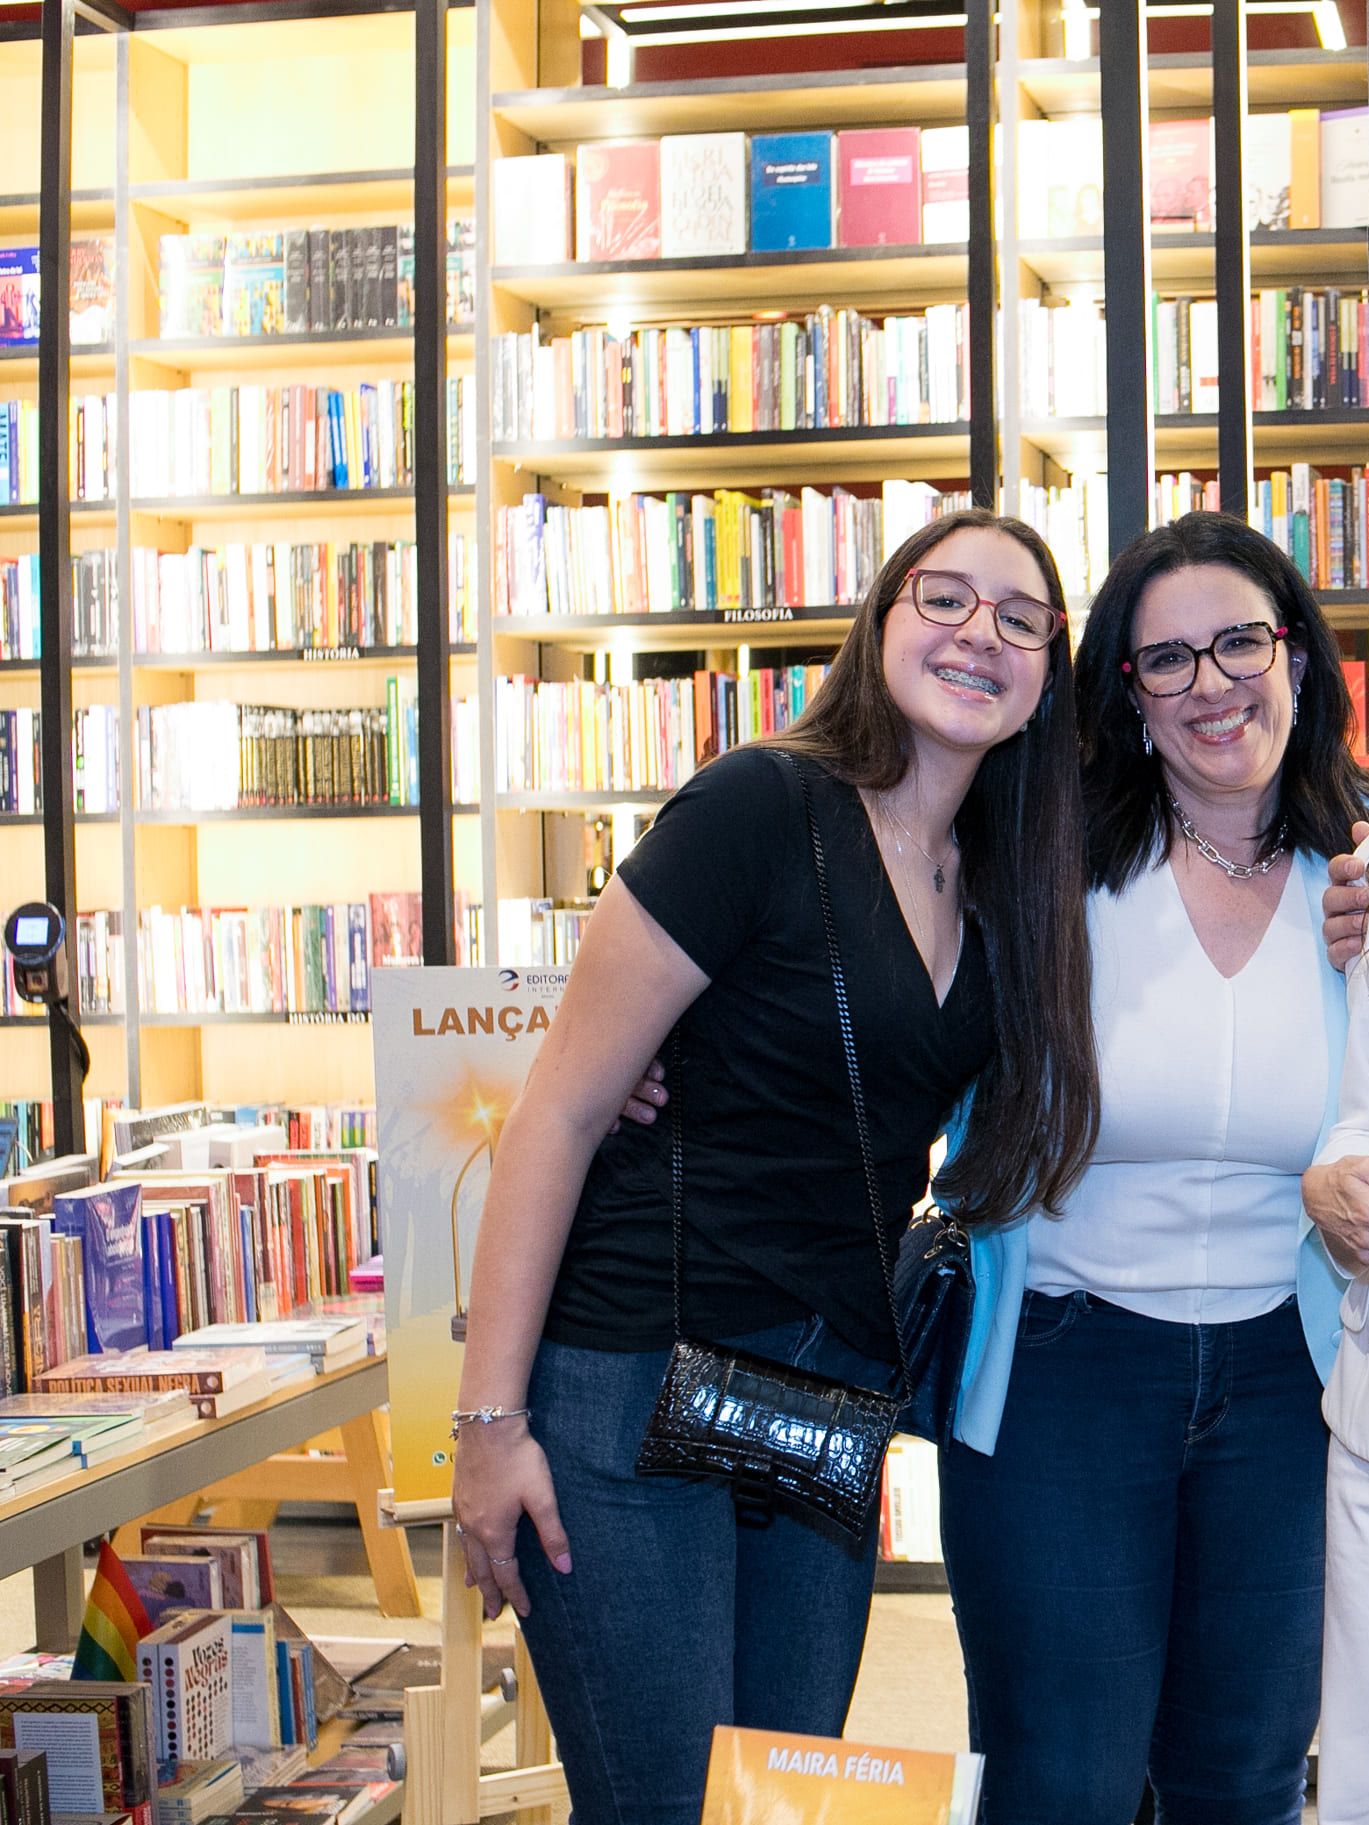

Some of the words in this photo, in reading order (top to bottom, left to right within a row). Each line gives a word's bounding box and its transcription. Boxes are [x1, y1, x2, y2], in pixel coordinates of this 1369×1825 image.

[723, 608, 794, 623] FILOSOFIA
[412, 1005, 558, 1042] LANÇA
[106, 1374, 154, 1393] SEXUAL
[766, 1746, 838, 1778] MAIRA
[844, 1752, 905, 1786] FÉRIA
